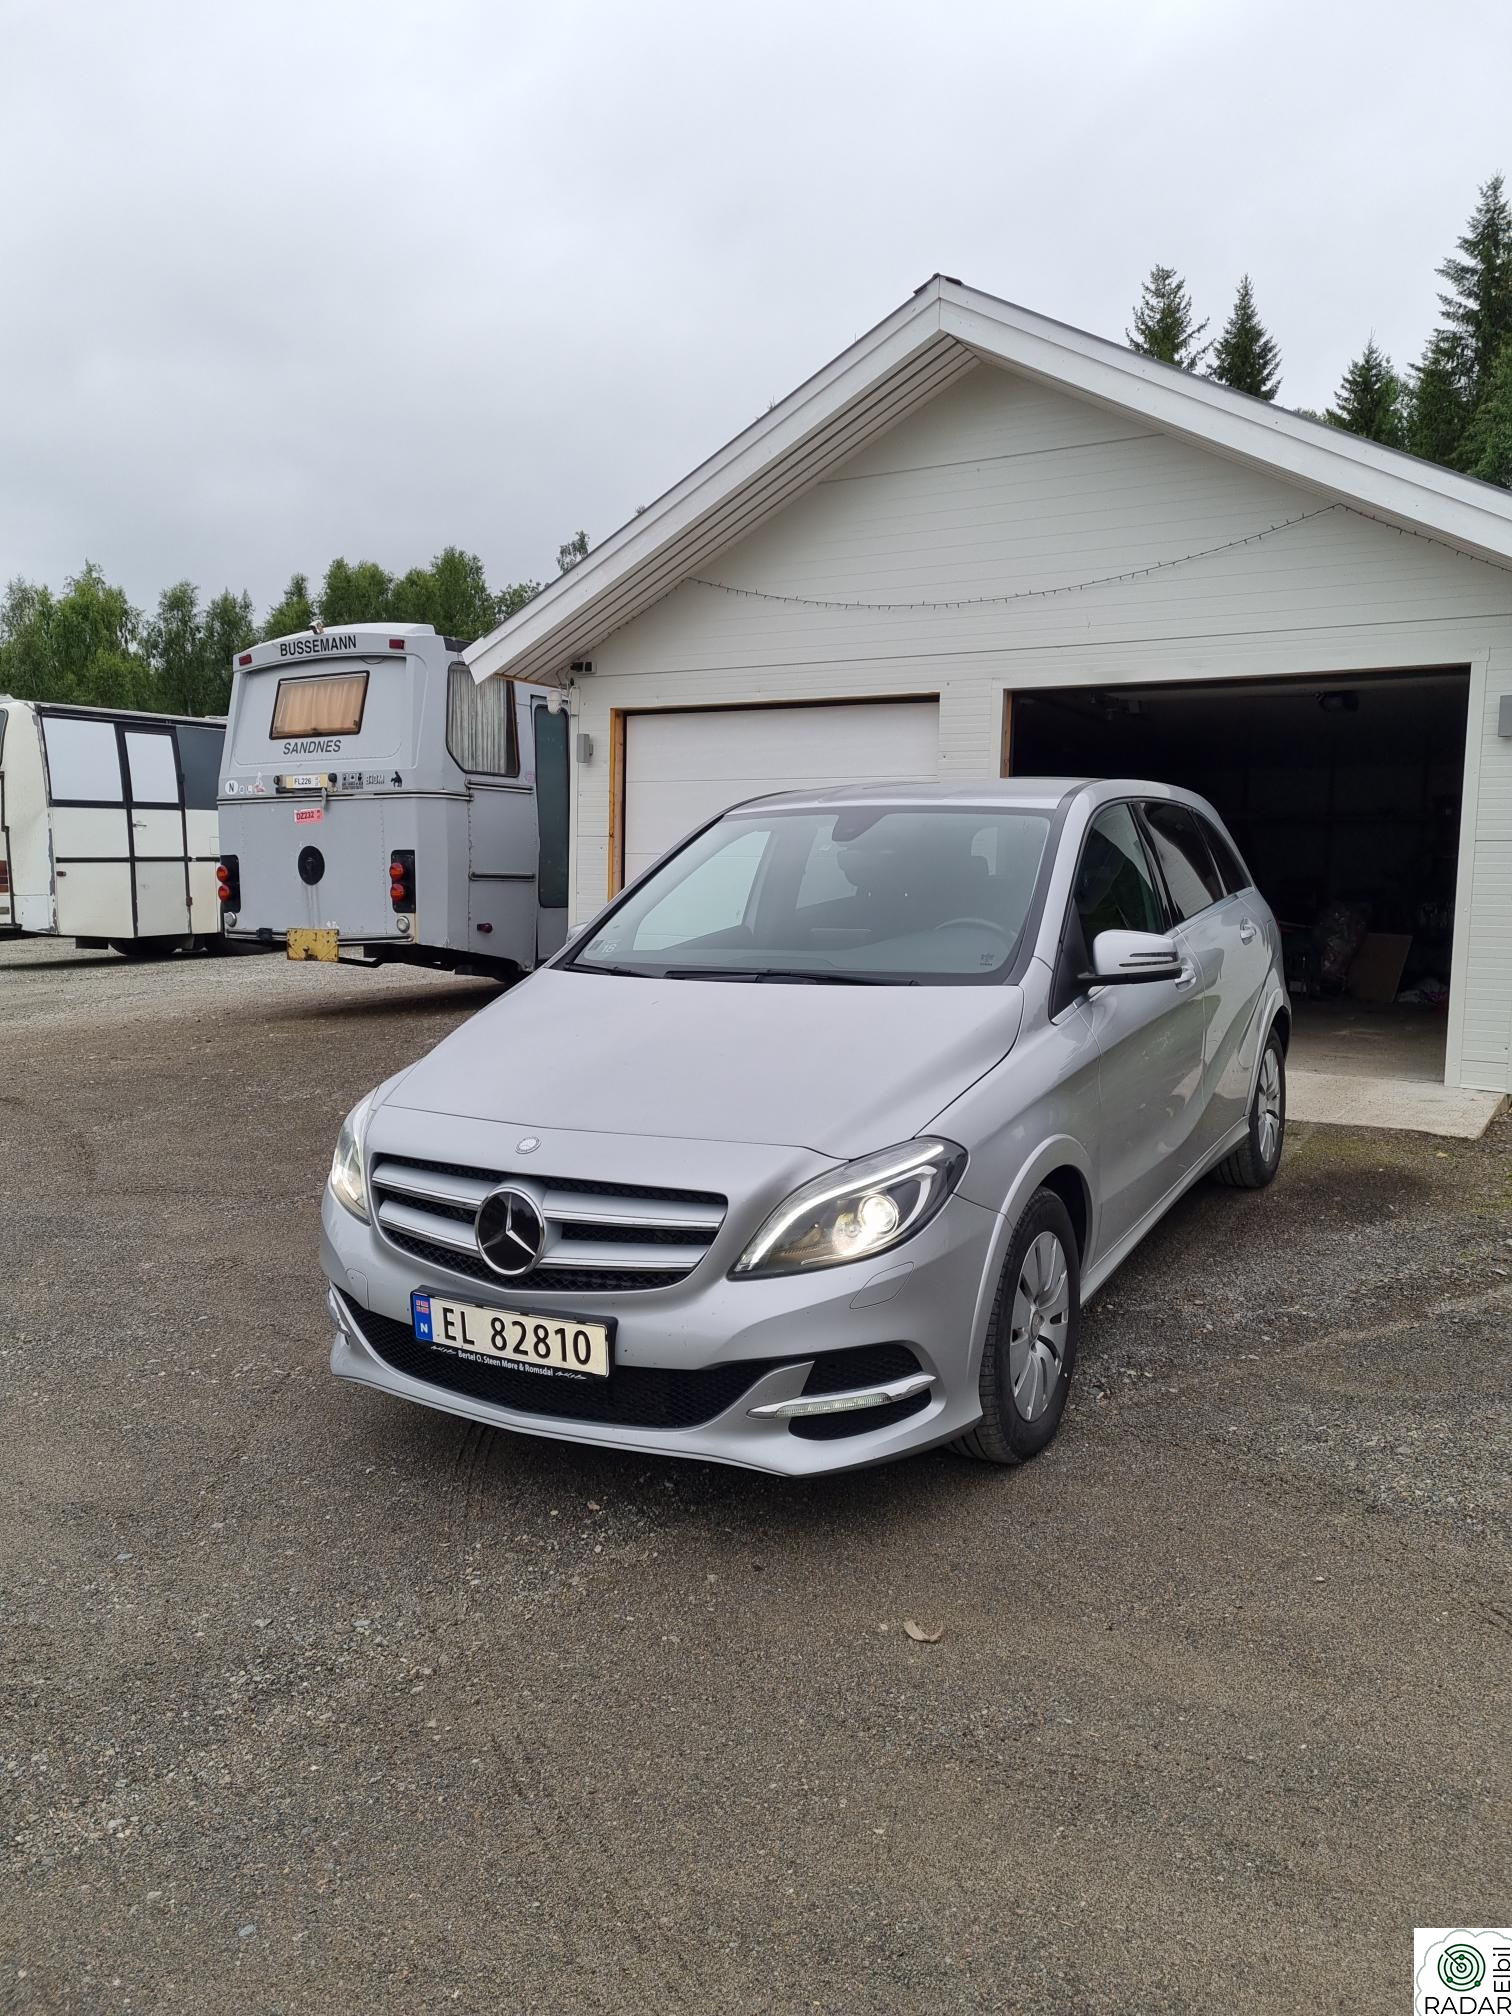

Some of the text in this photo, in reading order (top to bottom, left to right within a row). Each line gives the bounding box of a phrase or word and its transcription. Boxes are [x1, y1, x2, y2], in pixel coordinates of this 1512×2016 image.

[280, 635, 357, 657] BUSSEMANN
[283, 739, 342, 755] SANDNES
[420, 1322, 429, 1334] N
[442, 1306, 592, 1366] EL 82810
[457, 1349, 476, 1361] Bertel
[476, 1354, 484, 1363] O.
[483, 1356, 501, 1367] Steen
[518, 1363, 525, 1371] &
[525, 1364, 554, 1377] Romsdal
